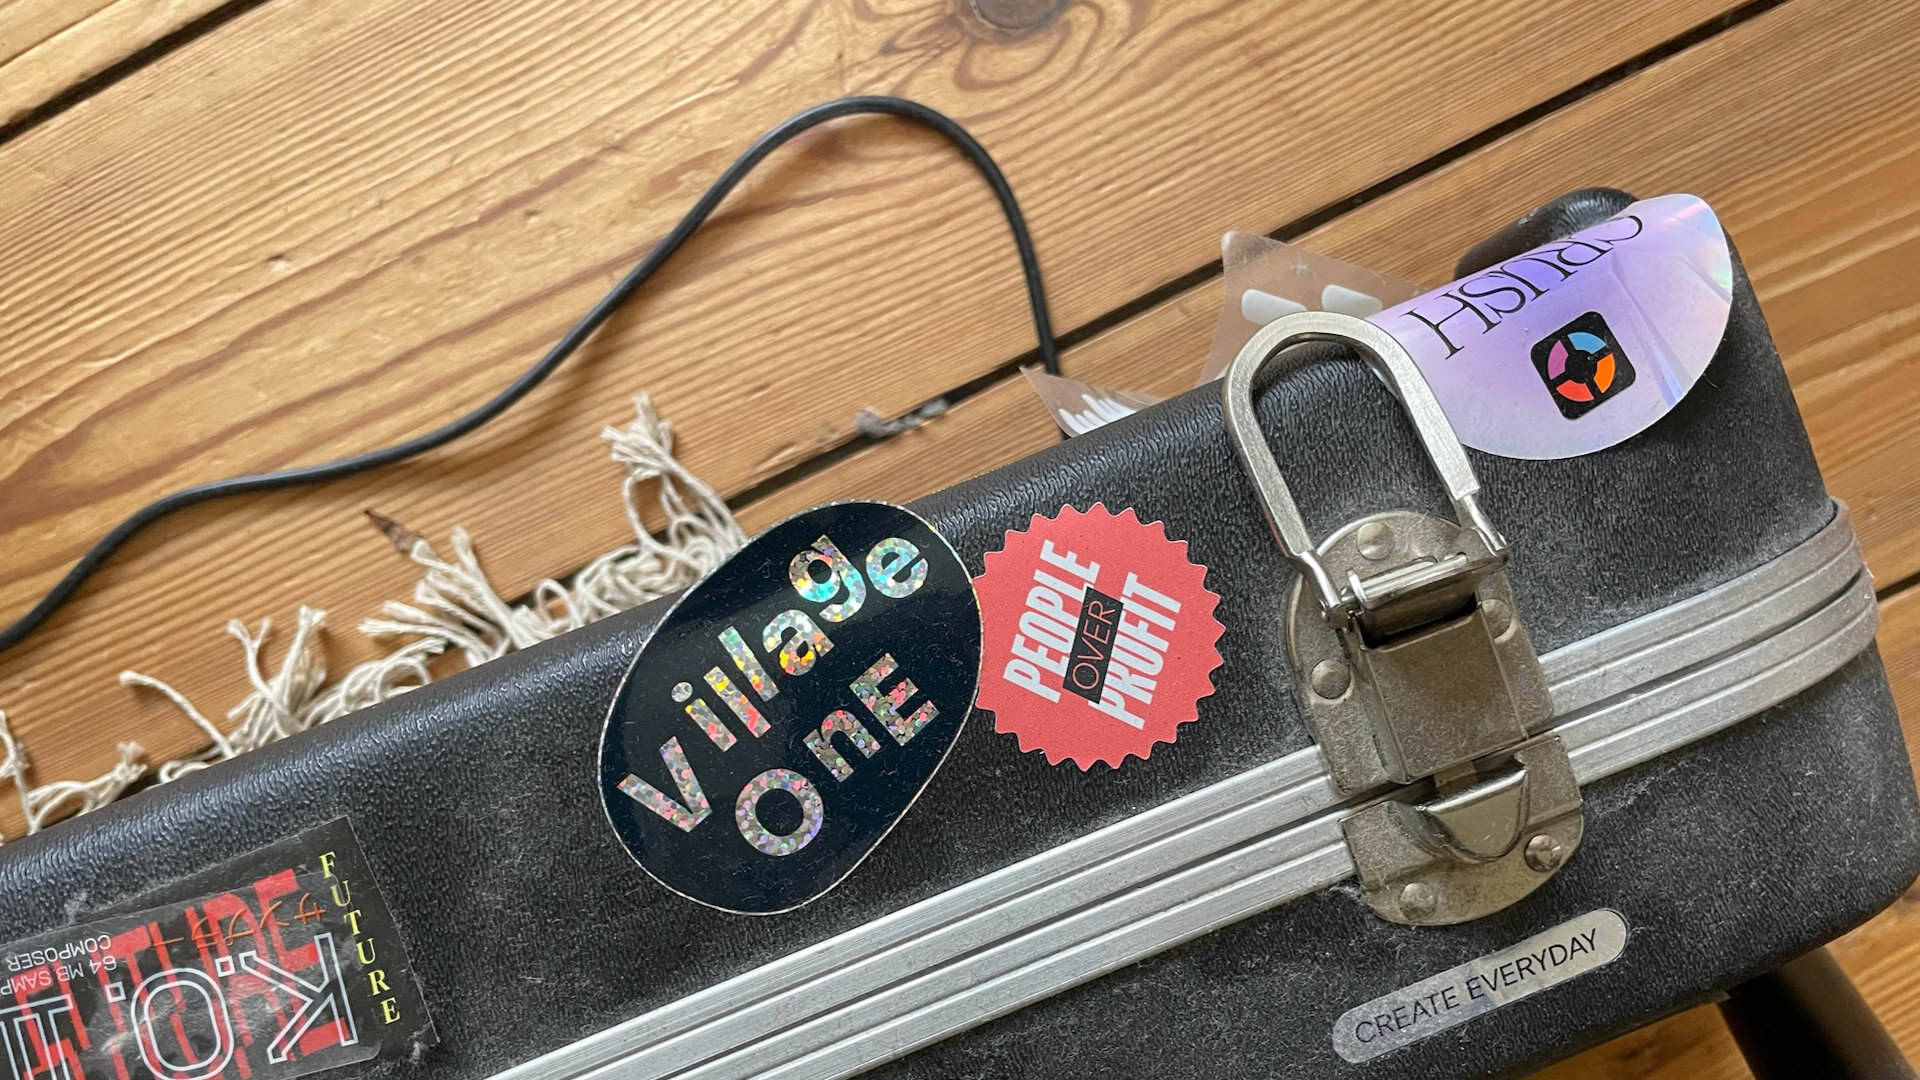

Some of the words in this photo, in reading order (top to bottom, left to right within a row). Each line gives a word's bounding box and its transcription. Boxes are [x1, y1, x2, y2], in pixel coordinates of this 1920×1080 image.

[1404, 215, 1644, 360] CRUSH
[617, 534, 929, 833] Village
[1002, 539, 1100, 704] PEOPLE
[1072, 600, 1115, 690] OVER
[1088, 571, 1182, 730] PROFIT
[6, 934, 112, 972] COMPOSER
[56, 963, 84, 982] MB
[89, 955, 117, 974] 64
[319, 851, 401, 1024] FUTURE
[1354, 986, 1460, 1043] CREATE
[1465, 928, 1597, 1000] EVERYDAY
